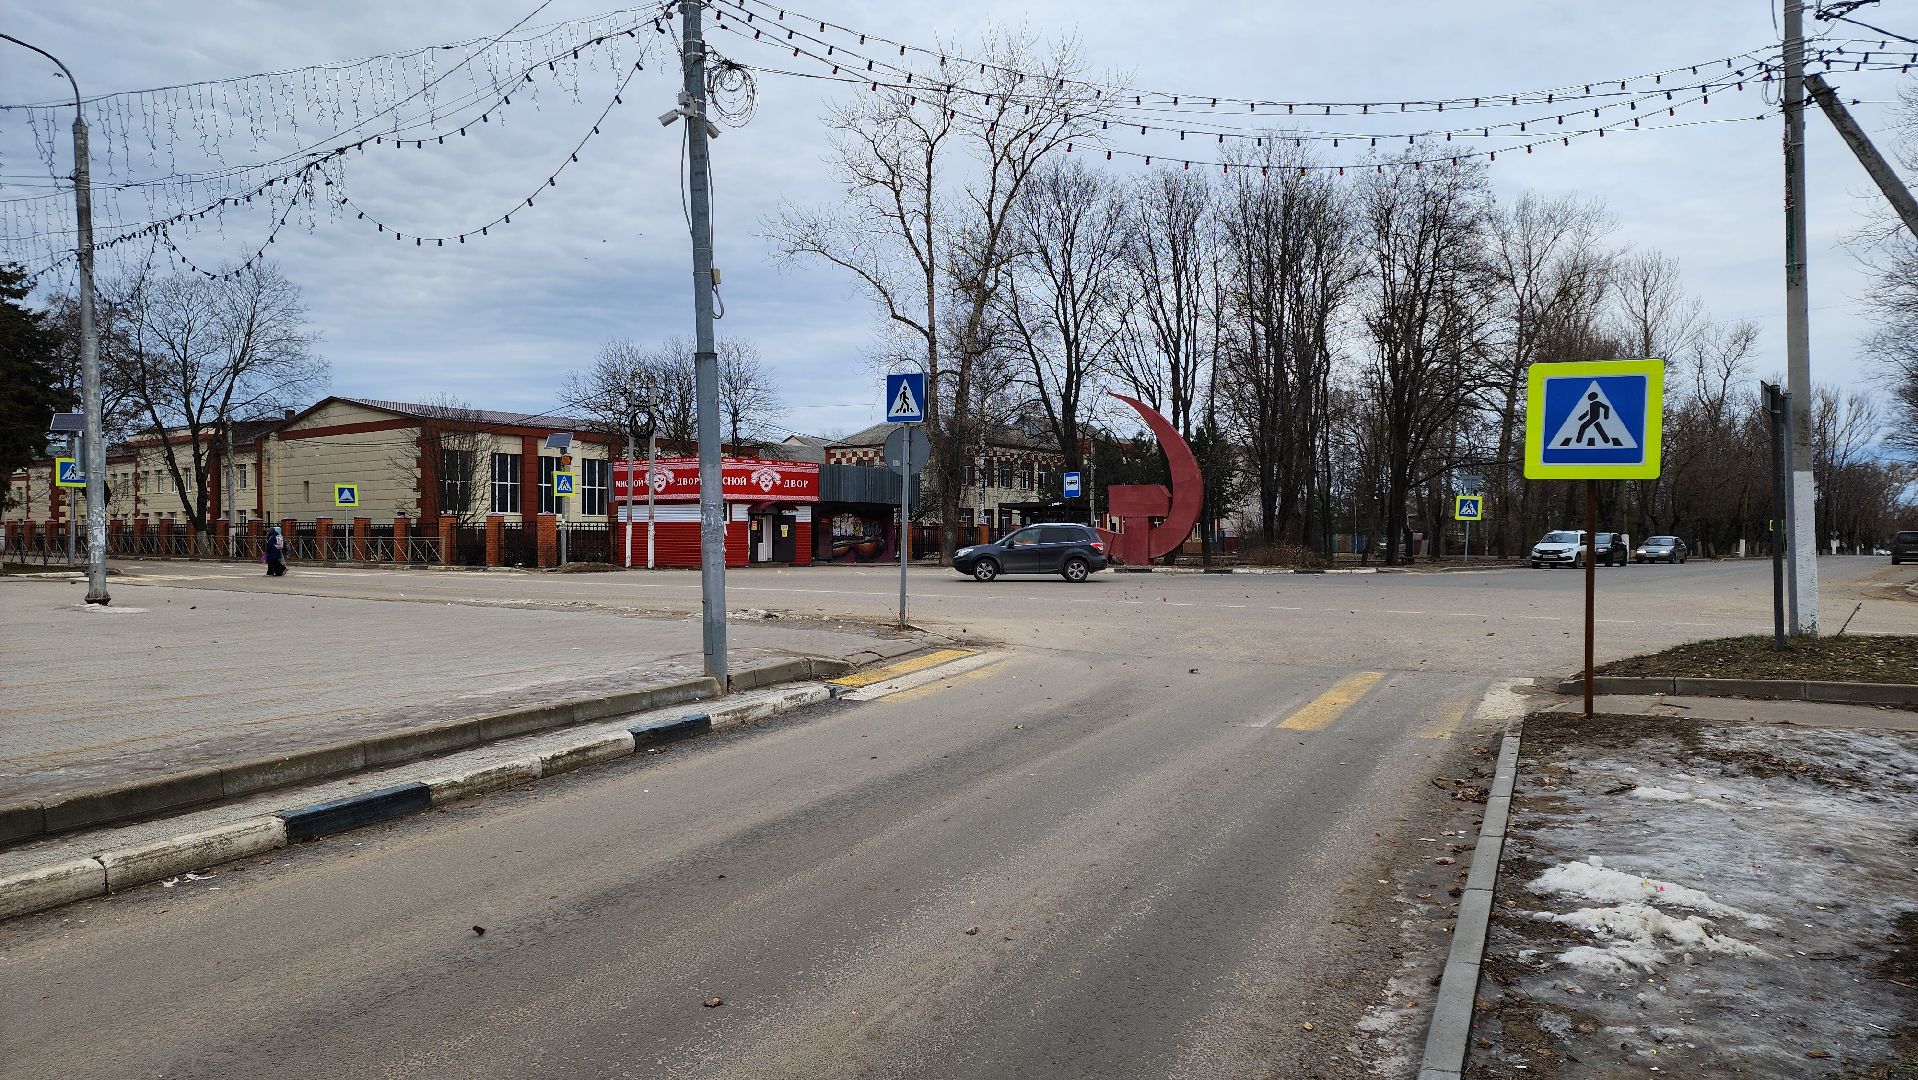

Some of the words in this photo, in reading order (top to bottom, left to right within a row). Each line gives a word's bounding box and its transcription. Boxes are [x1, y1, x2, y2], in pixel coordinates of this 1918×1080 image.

[677, 477, 700, 486] ДВОР
[722, 476, 747, 486] СНОЙ
[783, 479, 809, 488] ДВОР
